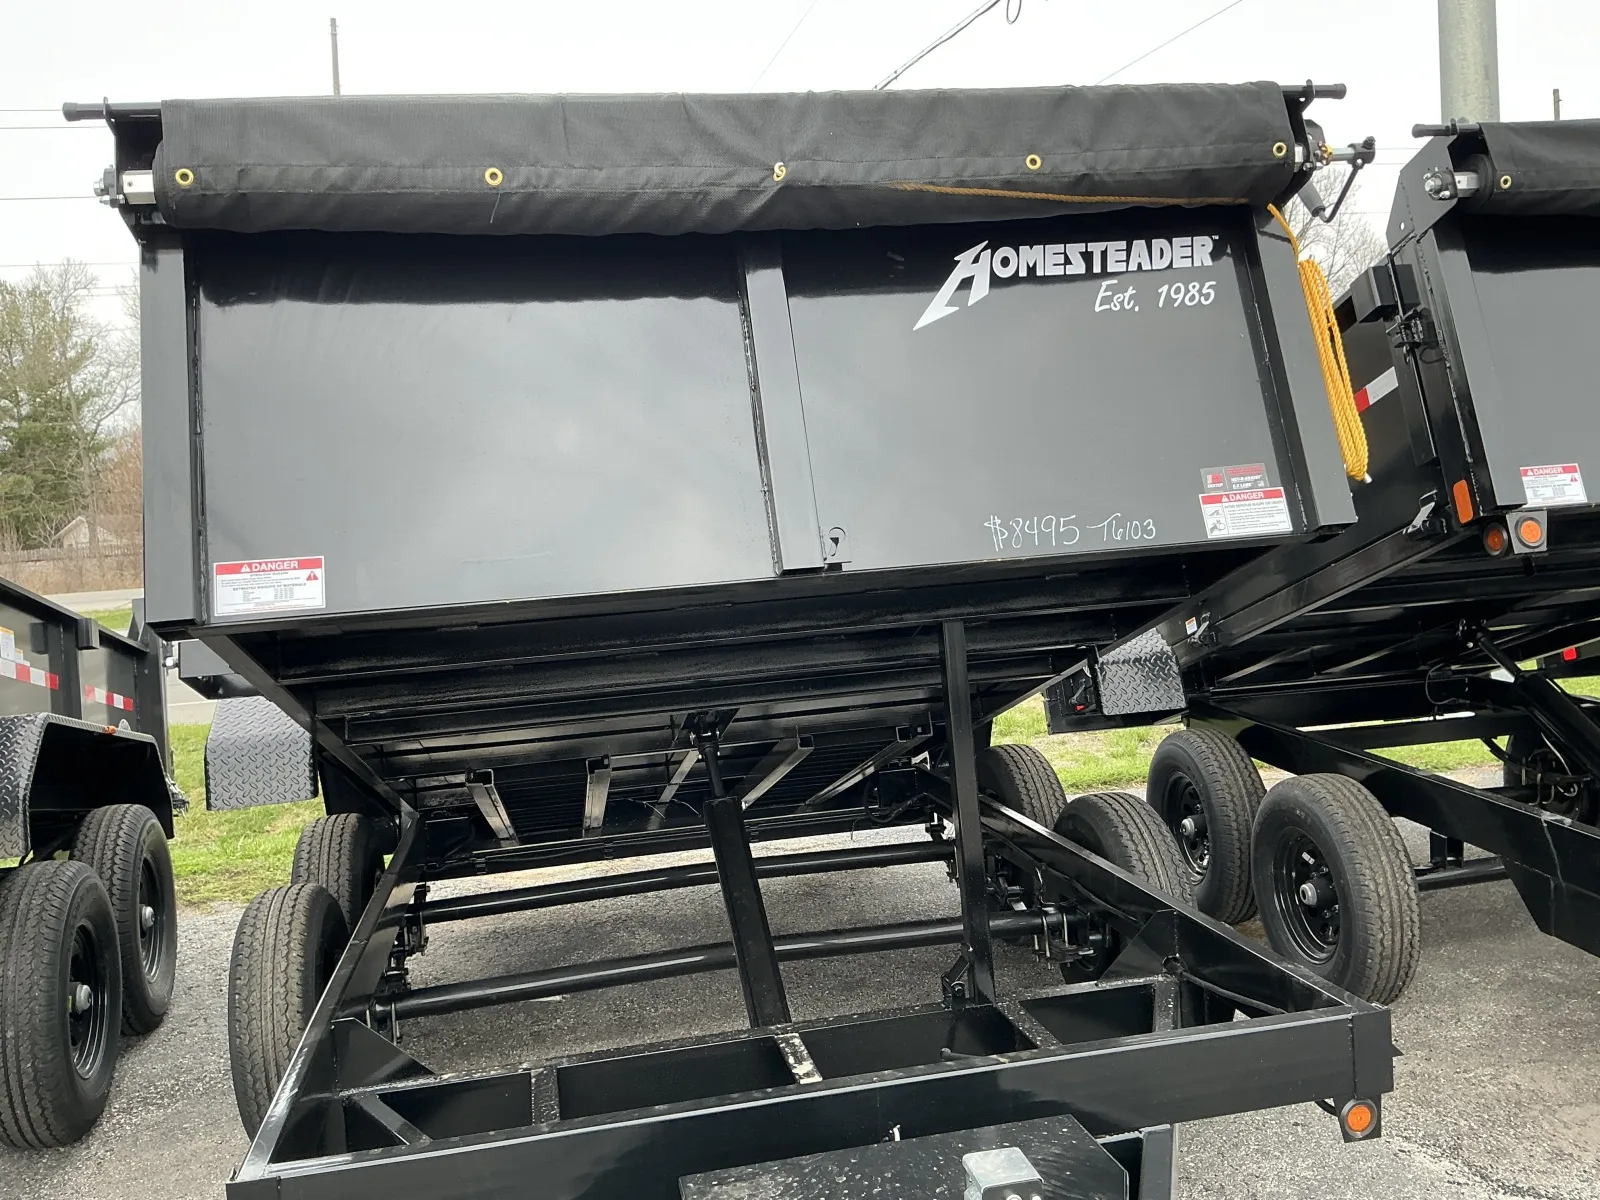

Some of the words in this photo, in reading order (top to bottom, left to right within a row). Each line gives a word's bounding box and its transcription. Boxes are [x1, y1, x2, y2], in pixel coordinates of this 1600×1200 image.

[1094, 280, 1140, 312] Est.
[1158, 281, 1216, 308] 1985
[1533, 467, 1564, 476] DANGER
[1229, 492, 1264, 501] DANGER
[984, 515, 1079, 551] $8495
[251, 560, 299, 572] DANGER
